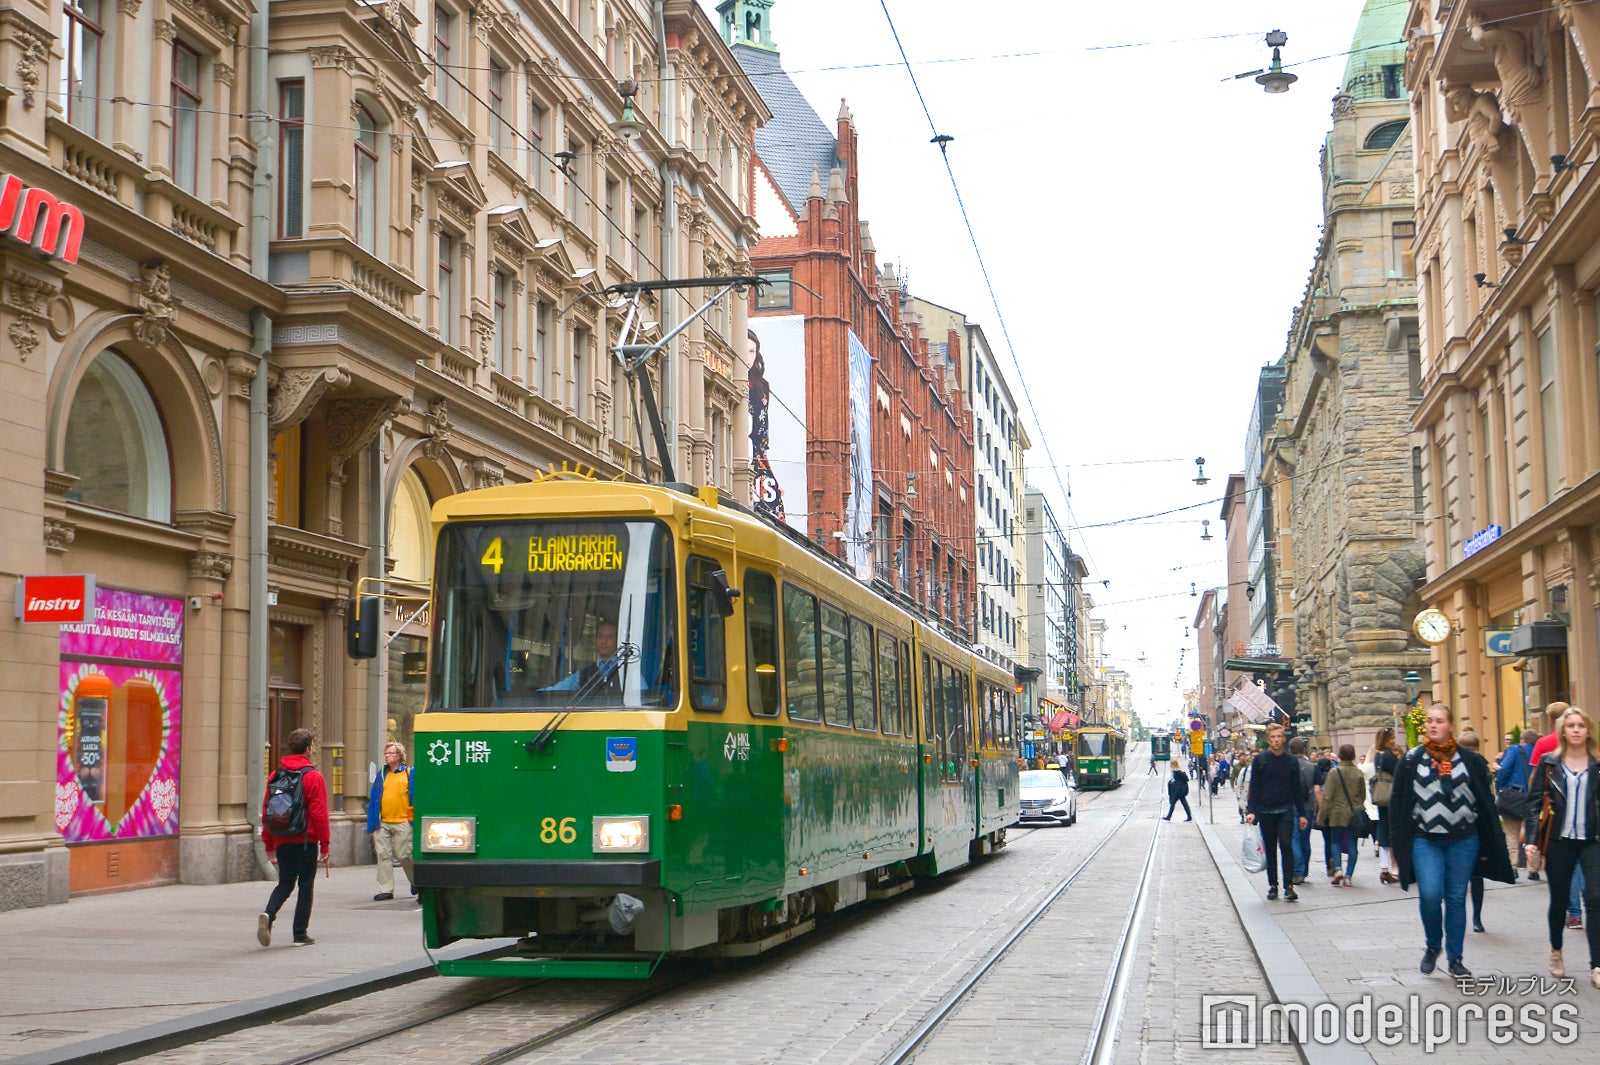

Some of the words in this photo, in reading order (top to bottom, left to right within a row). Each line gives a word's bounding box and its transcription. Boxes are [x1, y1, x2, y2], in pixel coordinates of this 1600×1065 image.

[481, 536, 504, 574] 4
[28, 596, 81, 611] instru
[107, 608, 137, 623] KESÄÄN
[102, 625, 112, 637] JA
[113, 626, 139, 640] UUDET
[465, 741, 491, 752] HSL
[737, 733, 750, 746] HKL
[465, 752, 491, 763] HRT
[539, 817, 577, 845] 86
